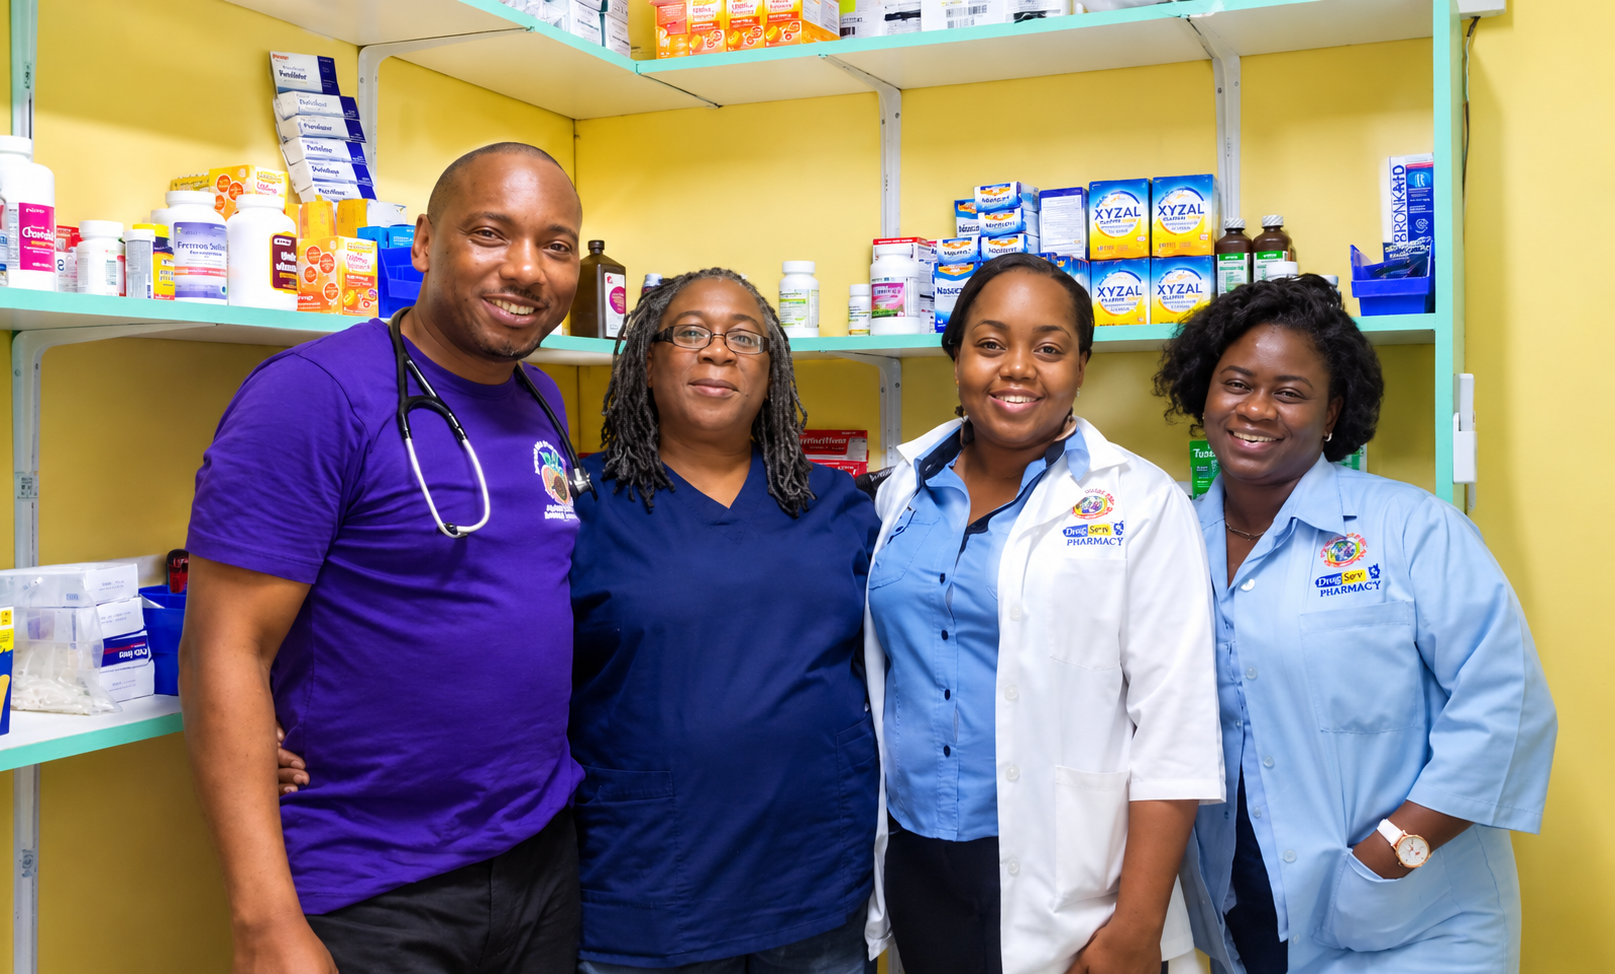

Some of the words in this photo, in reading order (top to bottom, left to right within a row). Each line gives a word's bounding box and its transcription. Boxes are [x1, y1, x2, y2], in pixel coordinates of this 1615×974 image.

[1095, 206, 1141, 220] XYZAL
[1158, 203, 1205, 216] XYZAL
[1097, 285, 1142, 297] XYZAL
[1157, 283, 1203, 295] XYZAL
[1067, 537, 1124, 546] PHARMACY
[1320, 580, 1381, 597] PHARMACY
